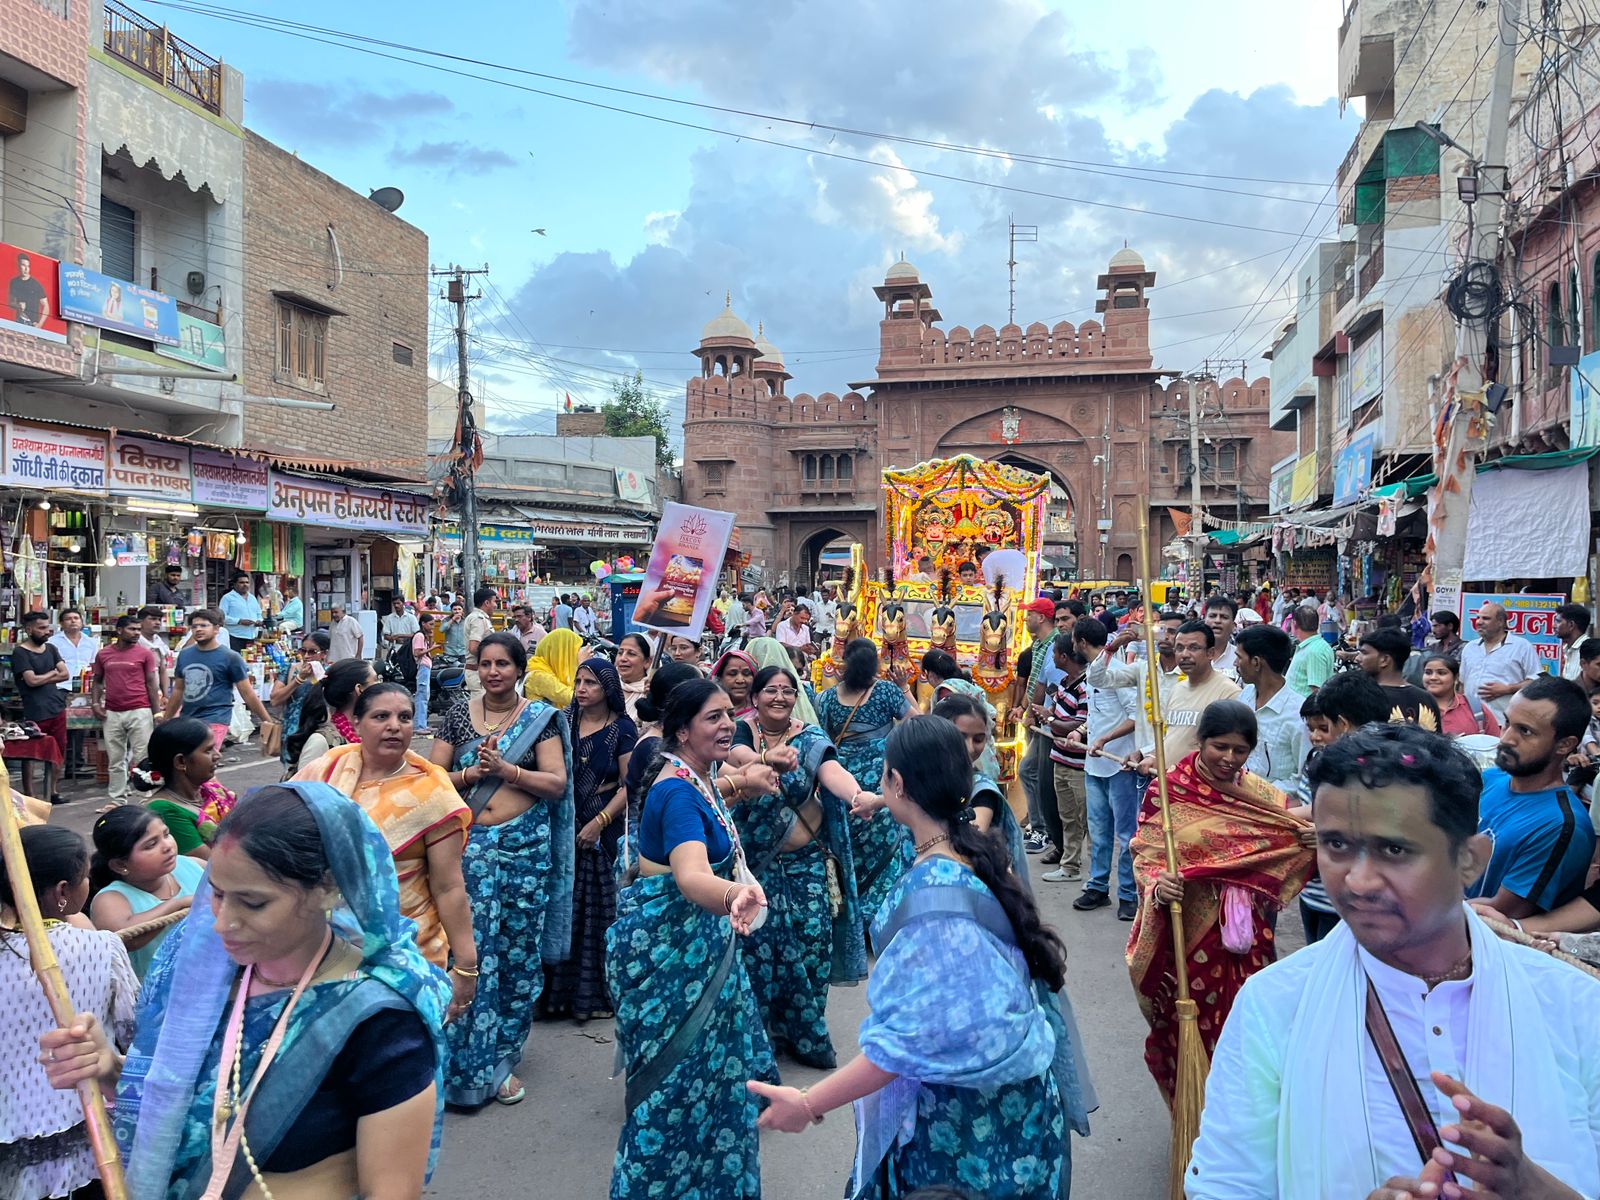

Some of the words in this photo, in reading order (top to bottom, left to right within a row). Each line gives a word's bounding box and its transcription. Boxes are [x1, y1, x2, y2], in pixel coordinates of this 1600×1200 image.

[12, 451, 42, 478] गाँधी
[116, 444, 184, 472] विजय
[113, 468, 148, 485] पान
[149, 472, 191, 492] भण्डार
[272, 481, 332, 518] अनुपम
[334, 487, 393, 520] होजयरी
[394, 496, 427, 525] स्टोर
[1167, 710, 1199, 726] AMIRI
